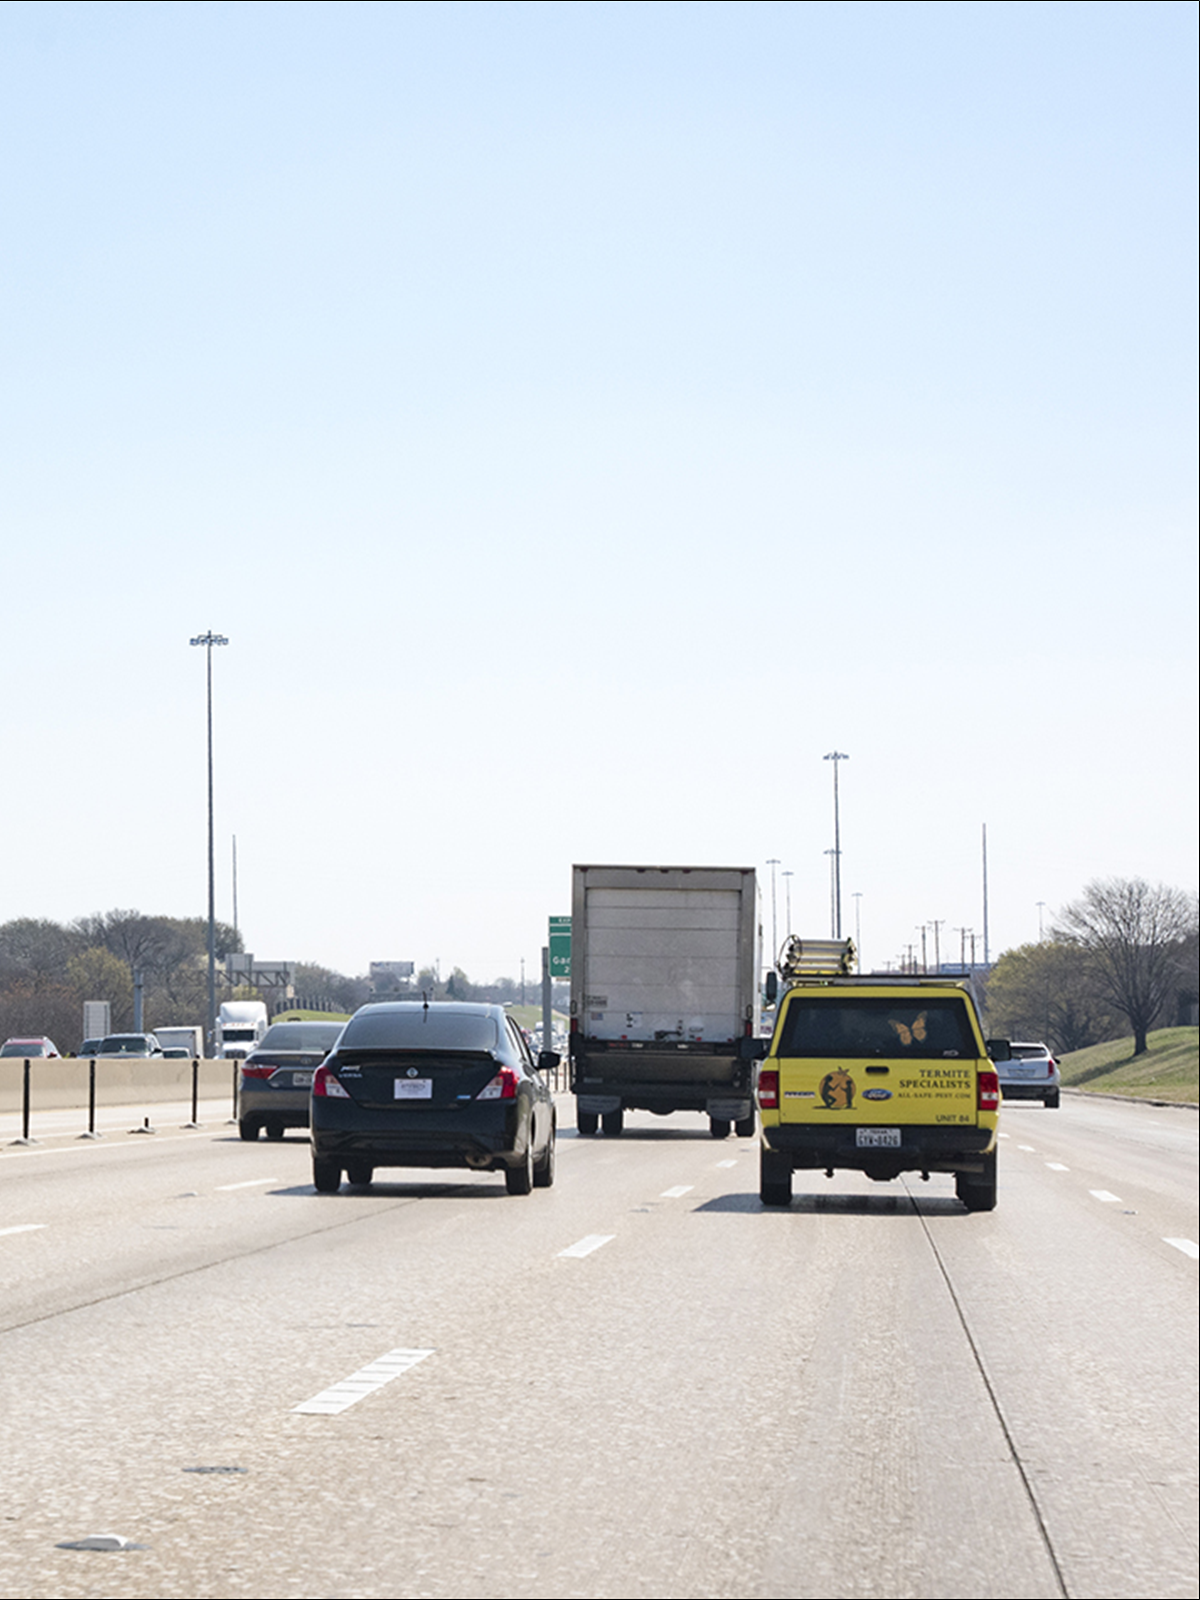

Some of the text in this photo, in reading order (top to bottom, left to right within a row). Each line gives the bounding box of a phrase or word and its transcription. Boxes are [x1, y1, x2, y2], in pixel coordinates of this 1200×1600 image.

[919, 1069, 971, 1078] TERMITE
[899, 1080, 971, 1089] SPECIALISTS
[935, 1114, 956, 1122] UNIT
